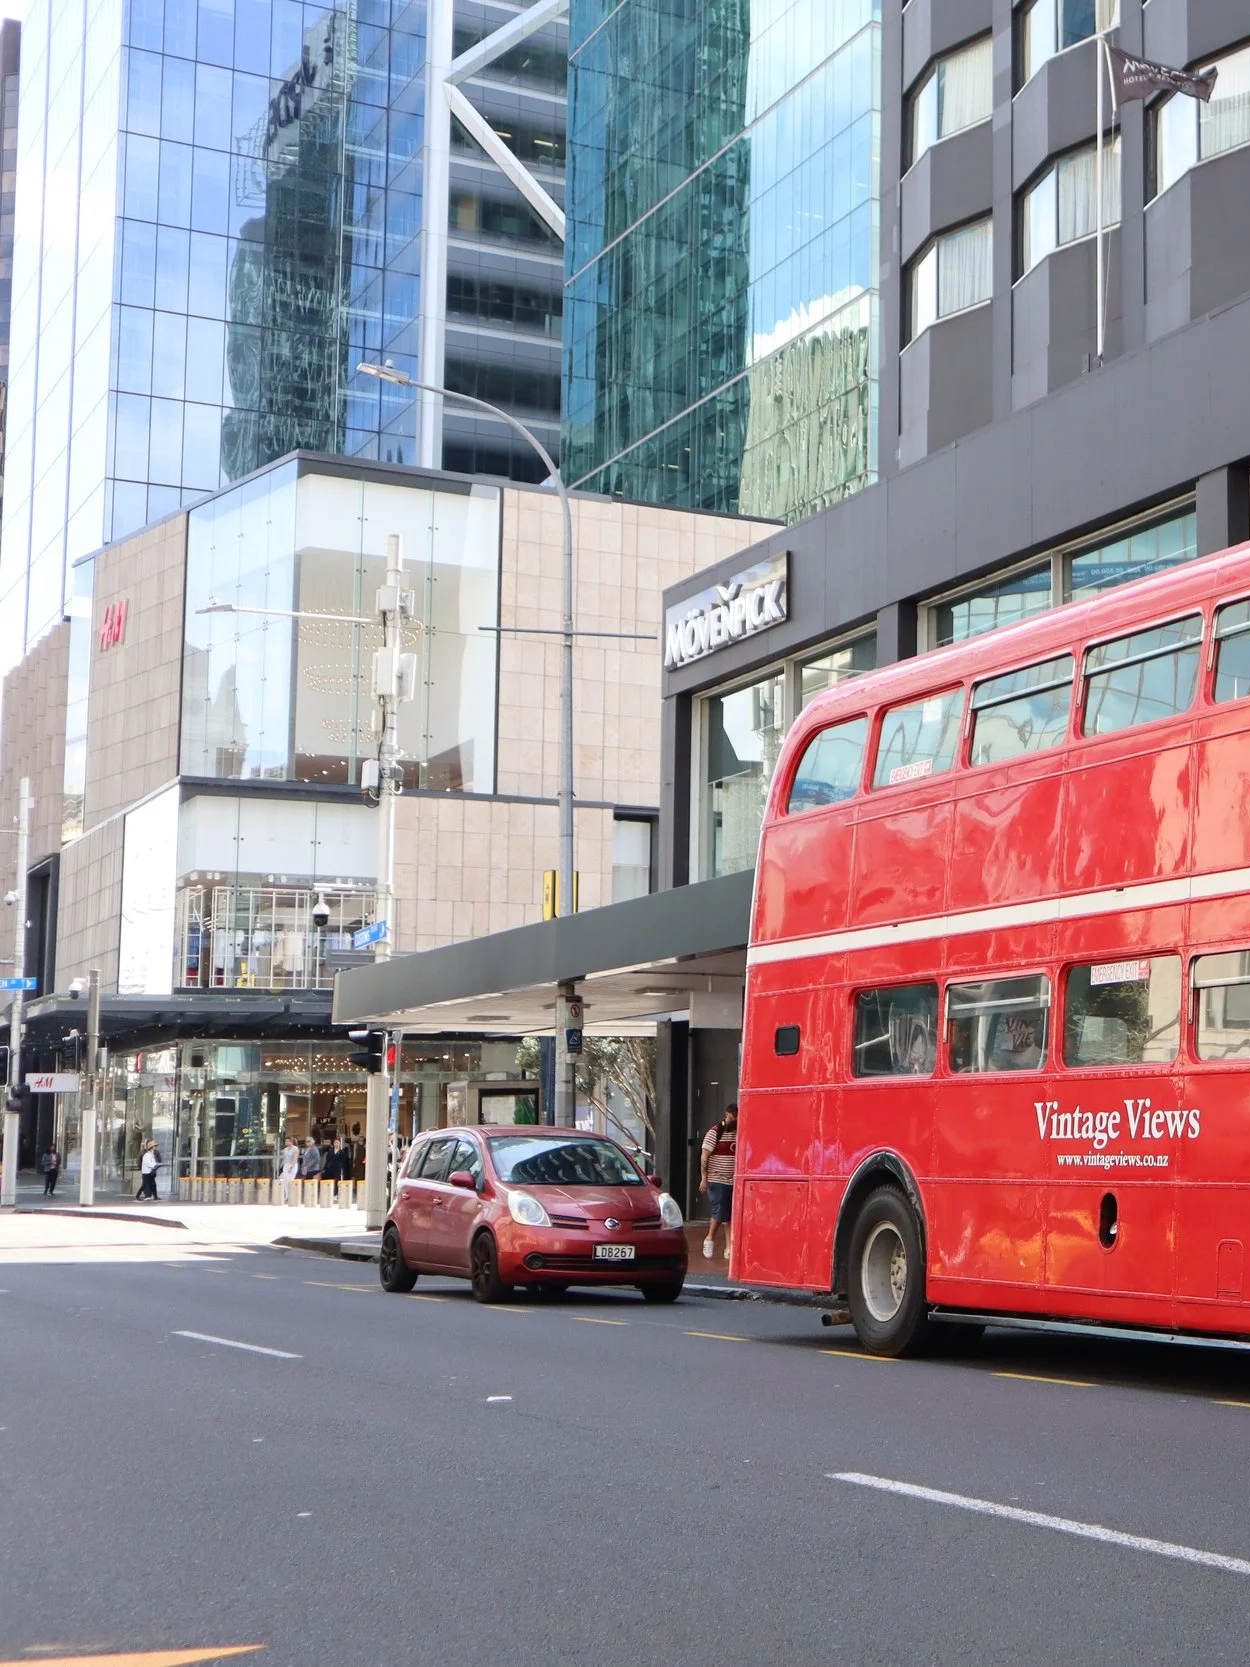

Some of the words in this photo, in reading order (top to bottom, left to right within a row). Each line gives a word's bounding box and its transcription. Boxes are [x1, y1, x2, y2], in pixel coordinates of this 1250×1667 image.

[664, 579, 786, 668] MÖVENPICK
[1092, 964, 1125, 984] EMERGENCY
[1126, 962, 1138, 979] EXIT
[1034, 1101, 1120, 1149] Vintage
[1123, 1098, 1200, 1139] Views
[1057, 1151, 1168, 1170] www.vintageviews.co.nz
[594, 1247, 633, 1258] LDB267
